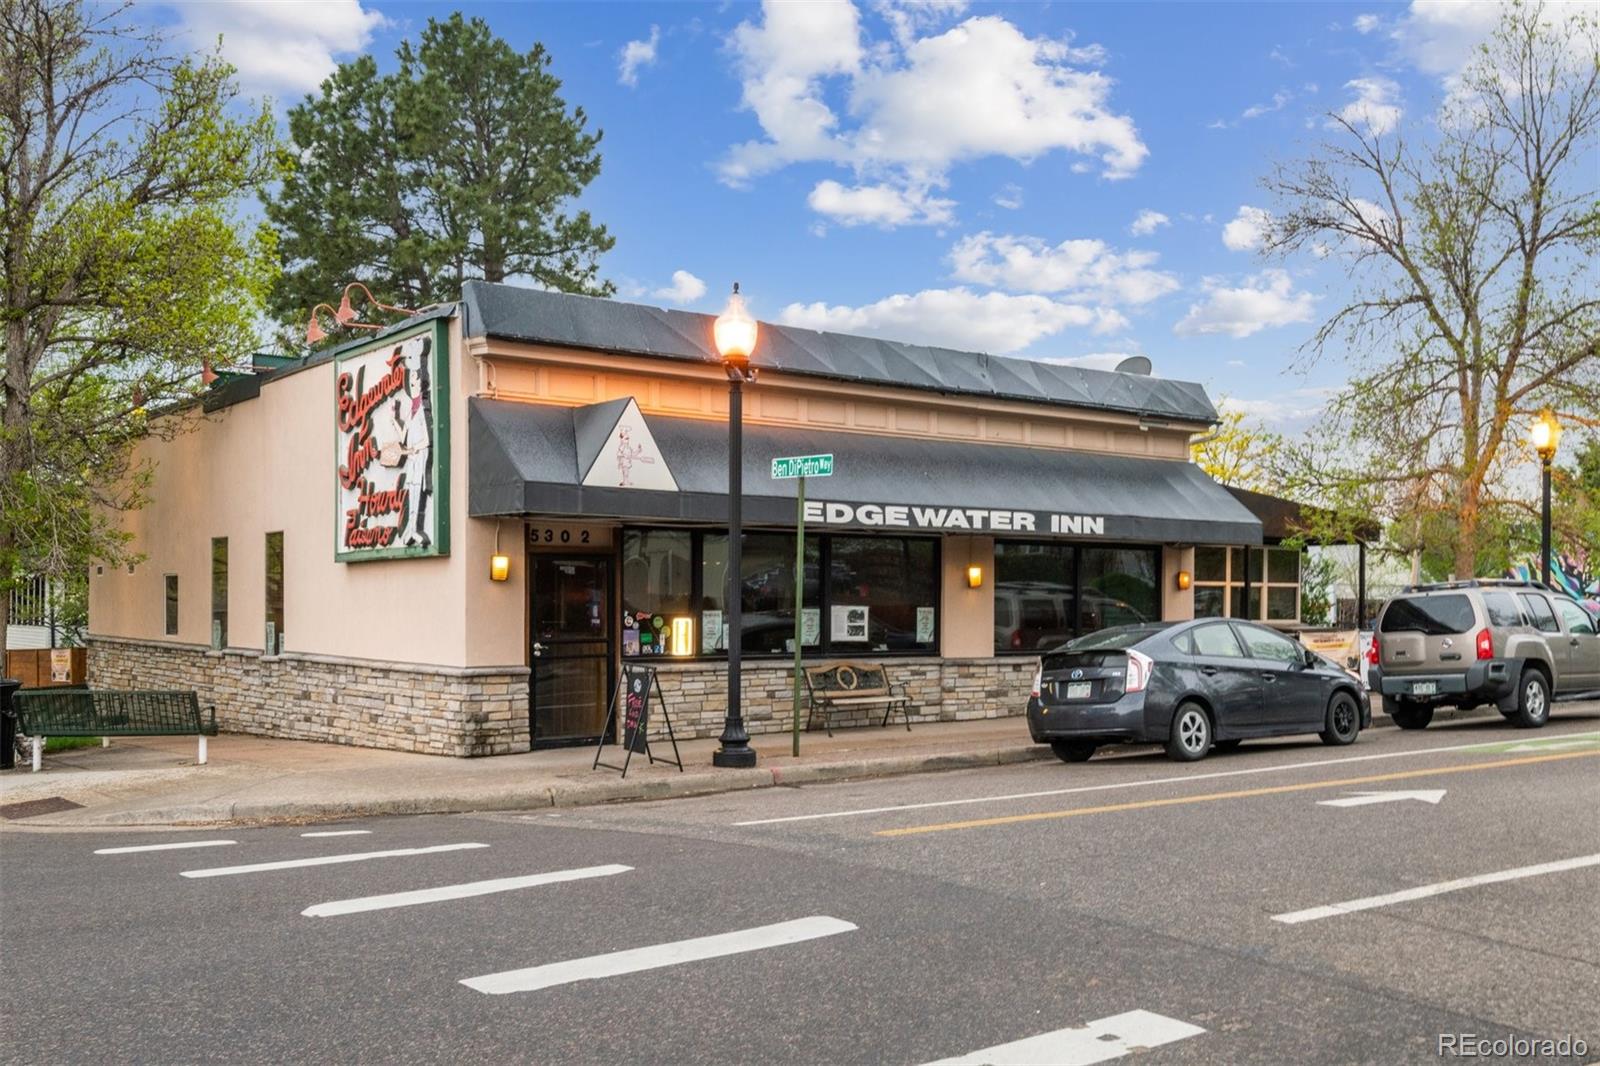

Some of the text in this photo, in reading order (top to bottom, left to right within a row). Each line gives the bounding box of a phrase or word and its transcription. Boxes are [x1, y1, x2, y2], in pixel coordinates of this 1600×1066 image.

[337, 347, 408, 442] Edgewater
[339, 434, 377, 488] Inn
[773, 458, 831, 477] Ben DiPietro Way
[358, 473, 409, 534] Howdy
[804, 501, 1104, 535] EDGEWATER INN
[530, 529, 590, 543] 5302
